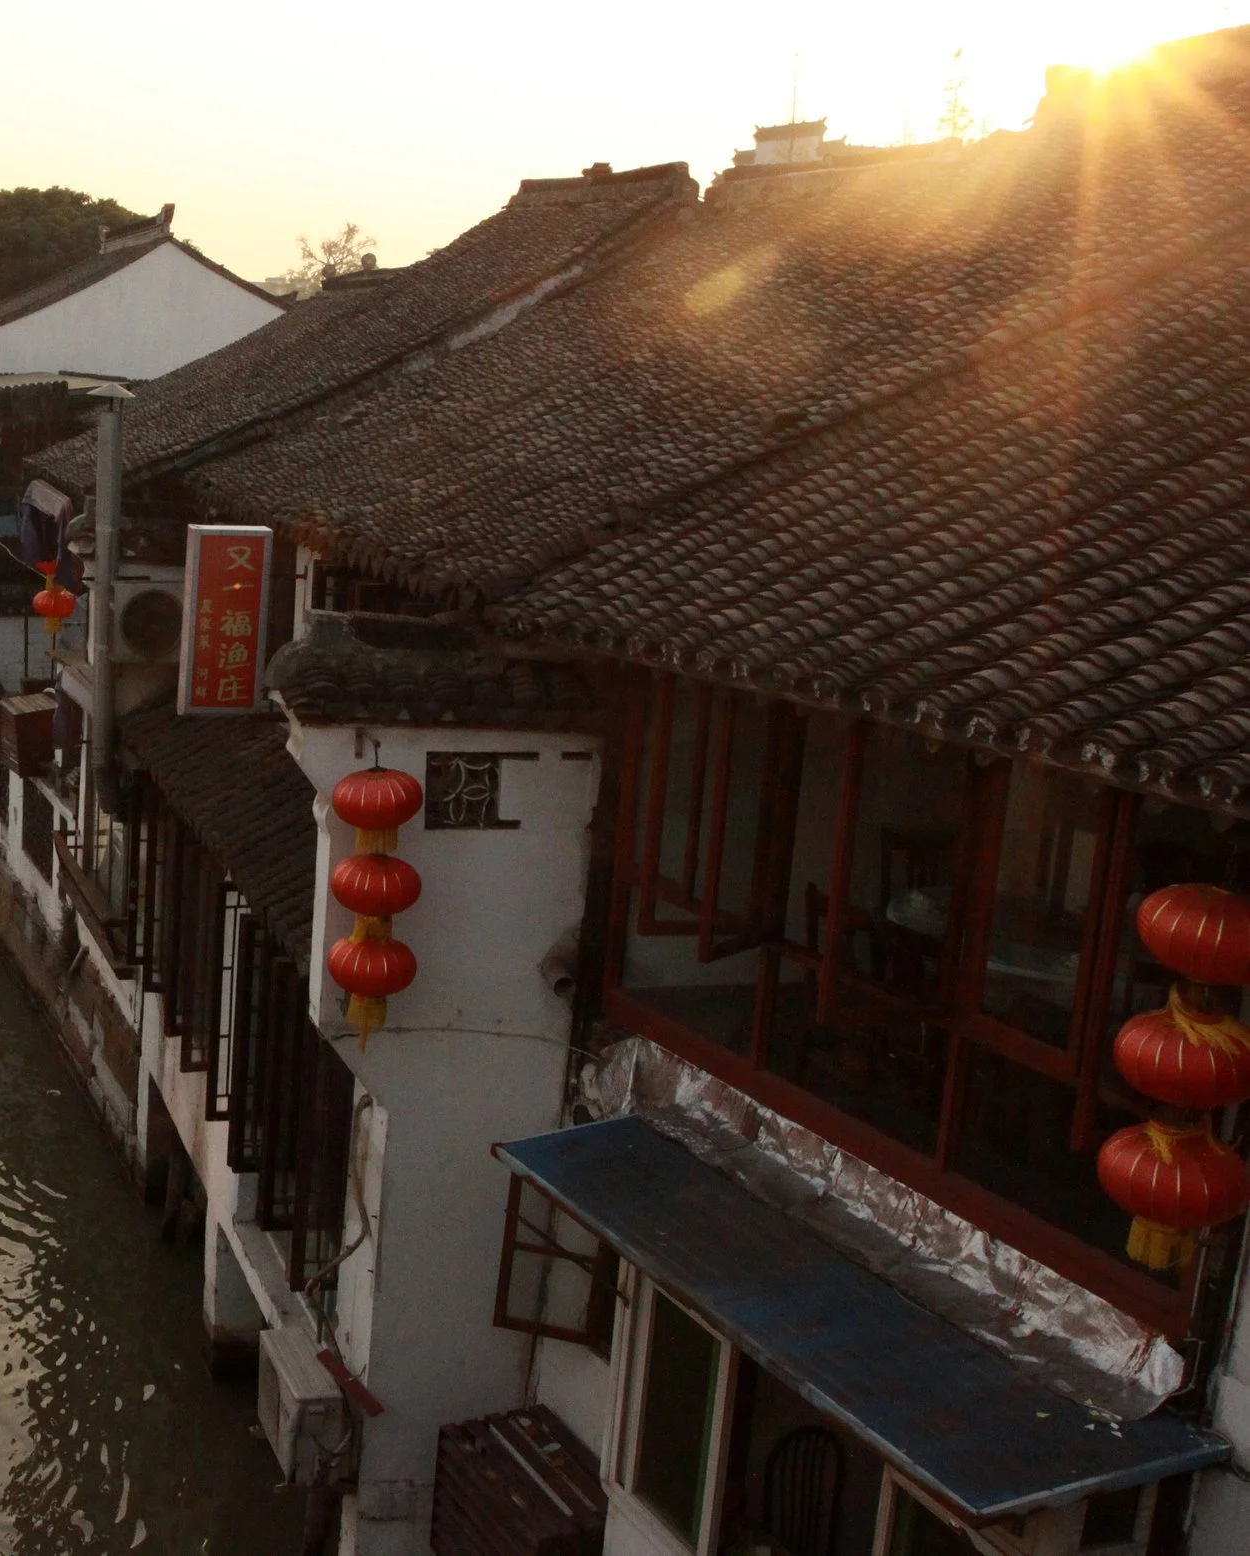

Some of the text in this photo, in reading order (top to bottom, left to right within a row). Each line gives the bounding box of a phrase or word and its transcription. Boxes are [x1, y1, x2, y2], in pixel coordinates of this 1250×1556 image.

[217, 546, 254, 701] 又一福渔庄
